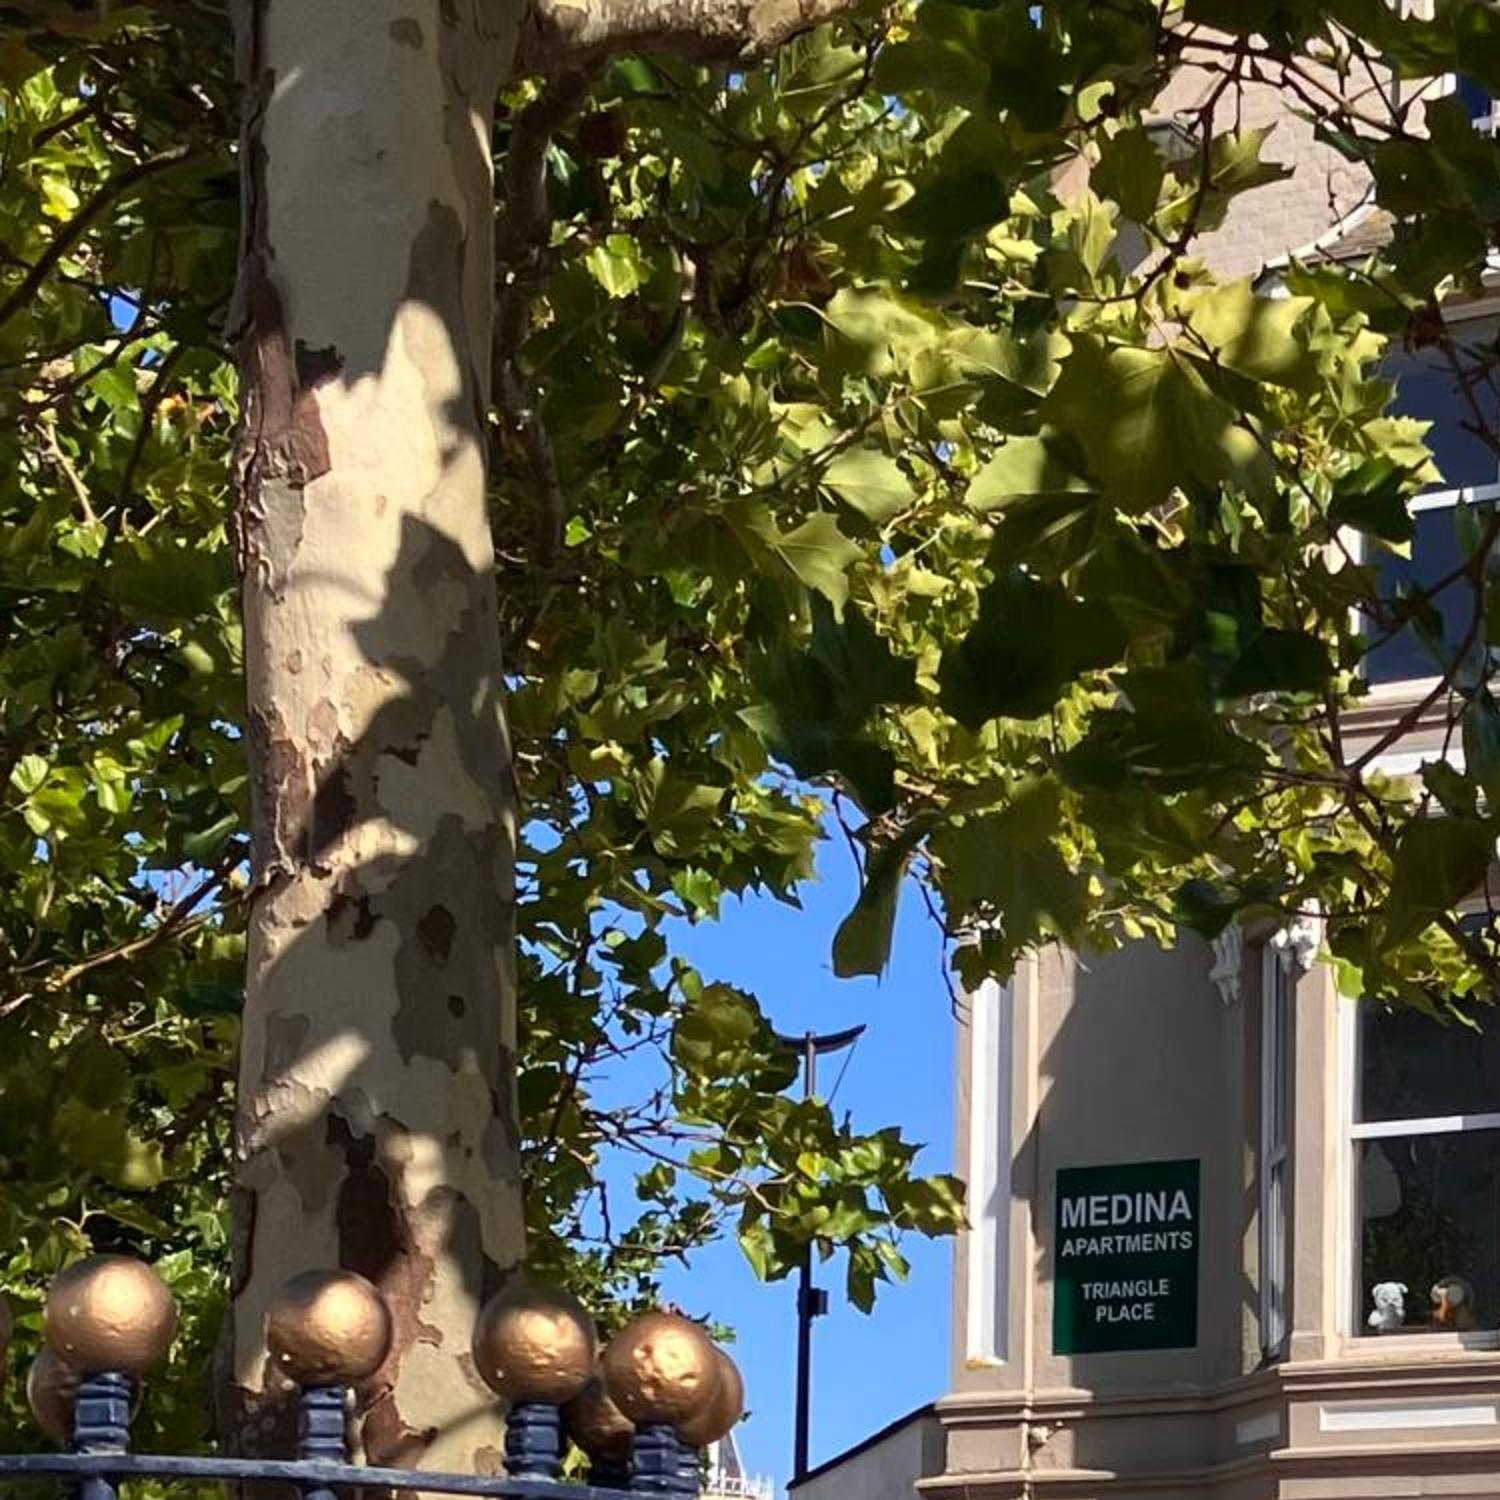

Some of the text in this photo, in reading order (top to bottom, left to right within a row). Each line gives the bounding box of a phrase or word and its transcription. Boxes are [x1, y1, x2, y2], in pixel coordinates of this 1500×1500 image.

[1060, 1189, 1193, 1229] MEDINA
[1060, 1230, 1194, 1258] APARTMENTS
[1081, 1278, 1170, 1301] TRIANGLE
[1095, 1302, 1155, 1323] PLACE
